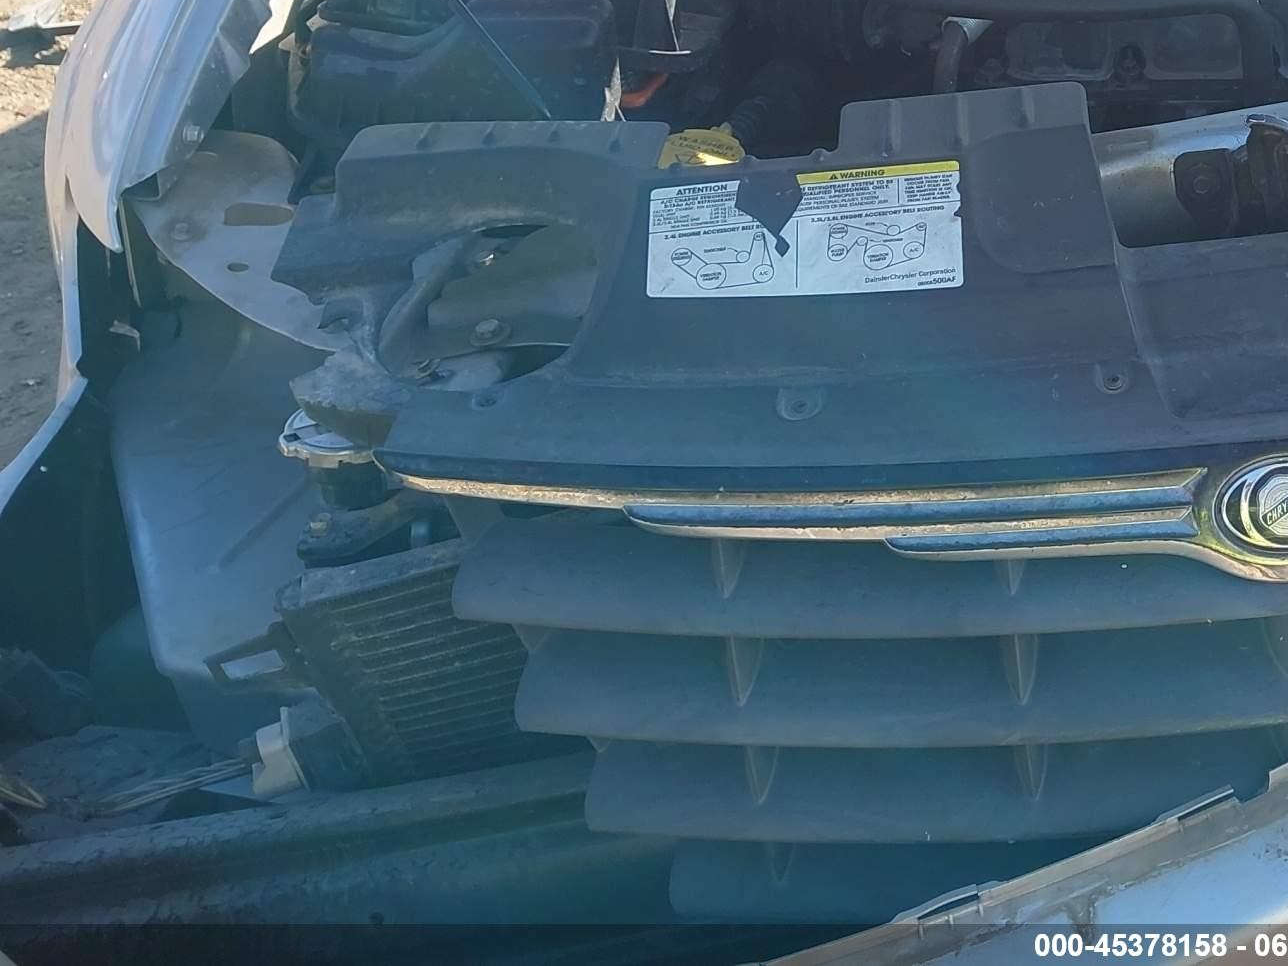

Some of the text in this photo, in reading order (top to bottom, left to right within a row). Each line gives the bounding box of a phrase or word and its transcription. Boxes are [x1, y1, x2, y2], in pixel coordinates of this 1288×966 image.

[839, 169, 885, 180] WARNING
[851, 179, 875, 188] SYSTEM
[676, 184, 728, 196] ATTENTION
[833, 186, 870, 195] PERSONNEL
[864, 210, 901, 218] ACCESSORY
[702, 226, 740, 236] ACCESSORY
[918, 266, 956, 277] Corporation
[865, 271, 917, 283] DaimlerChrysler
